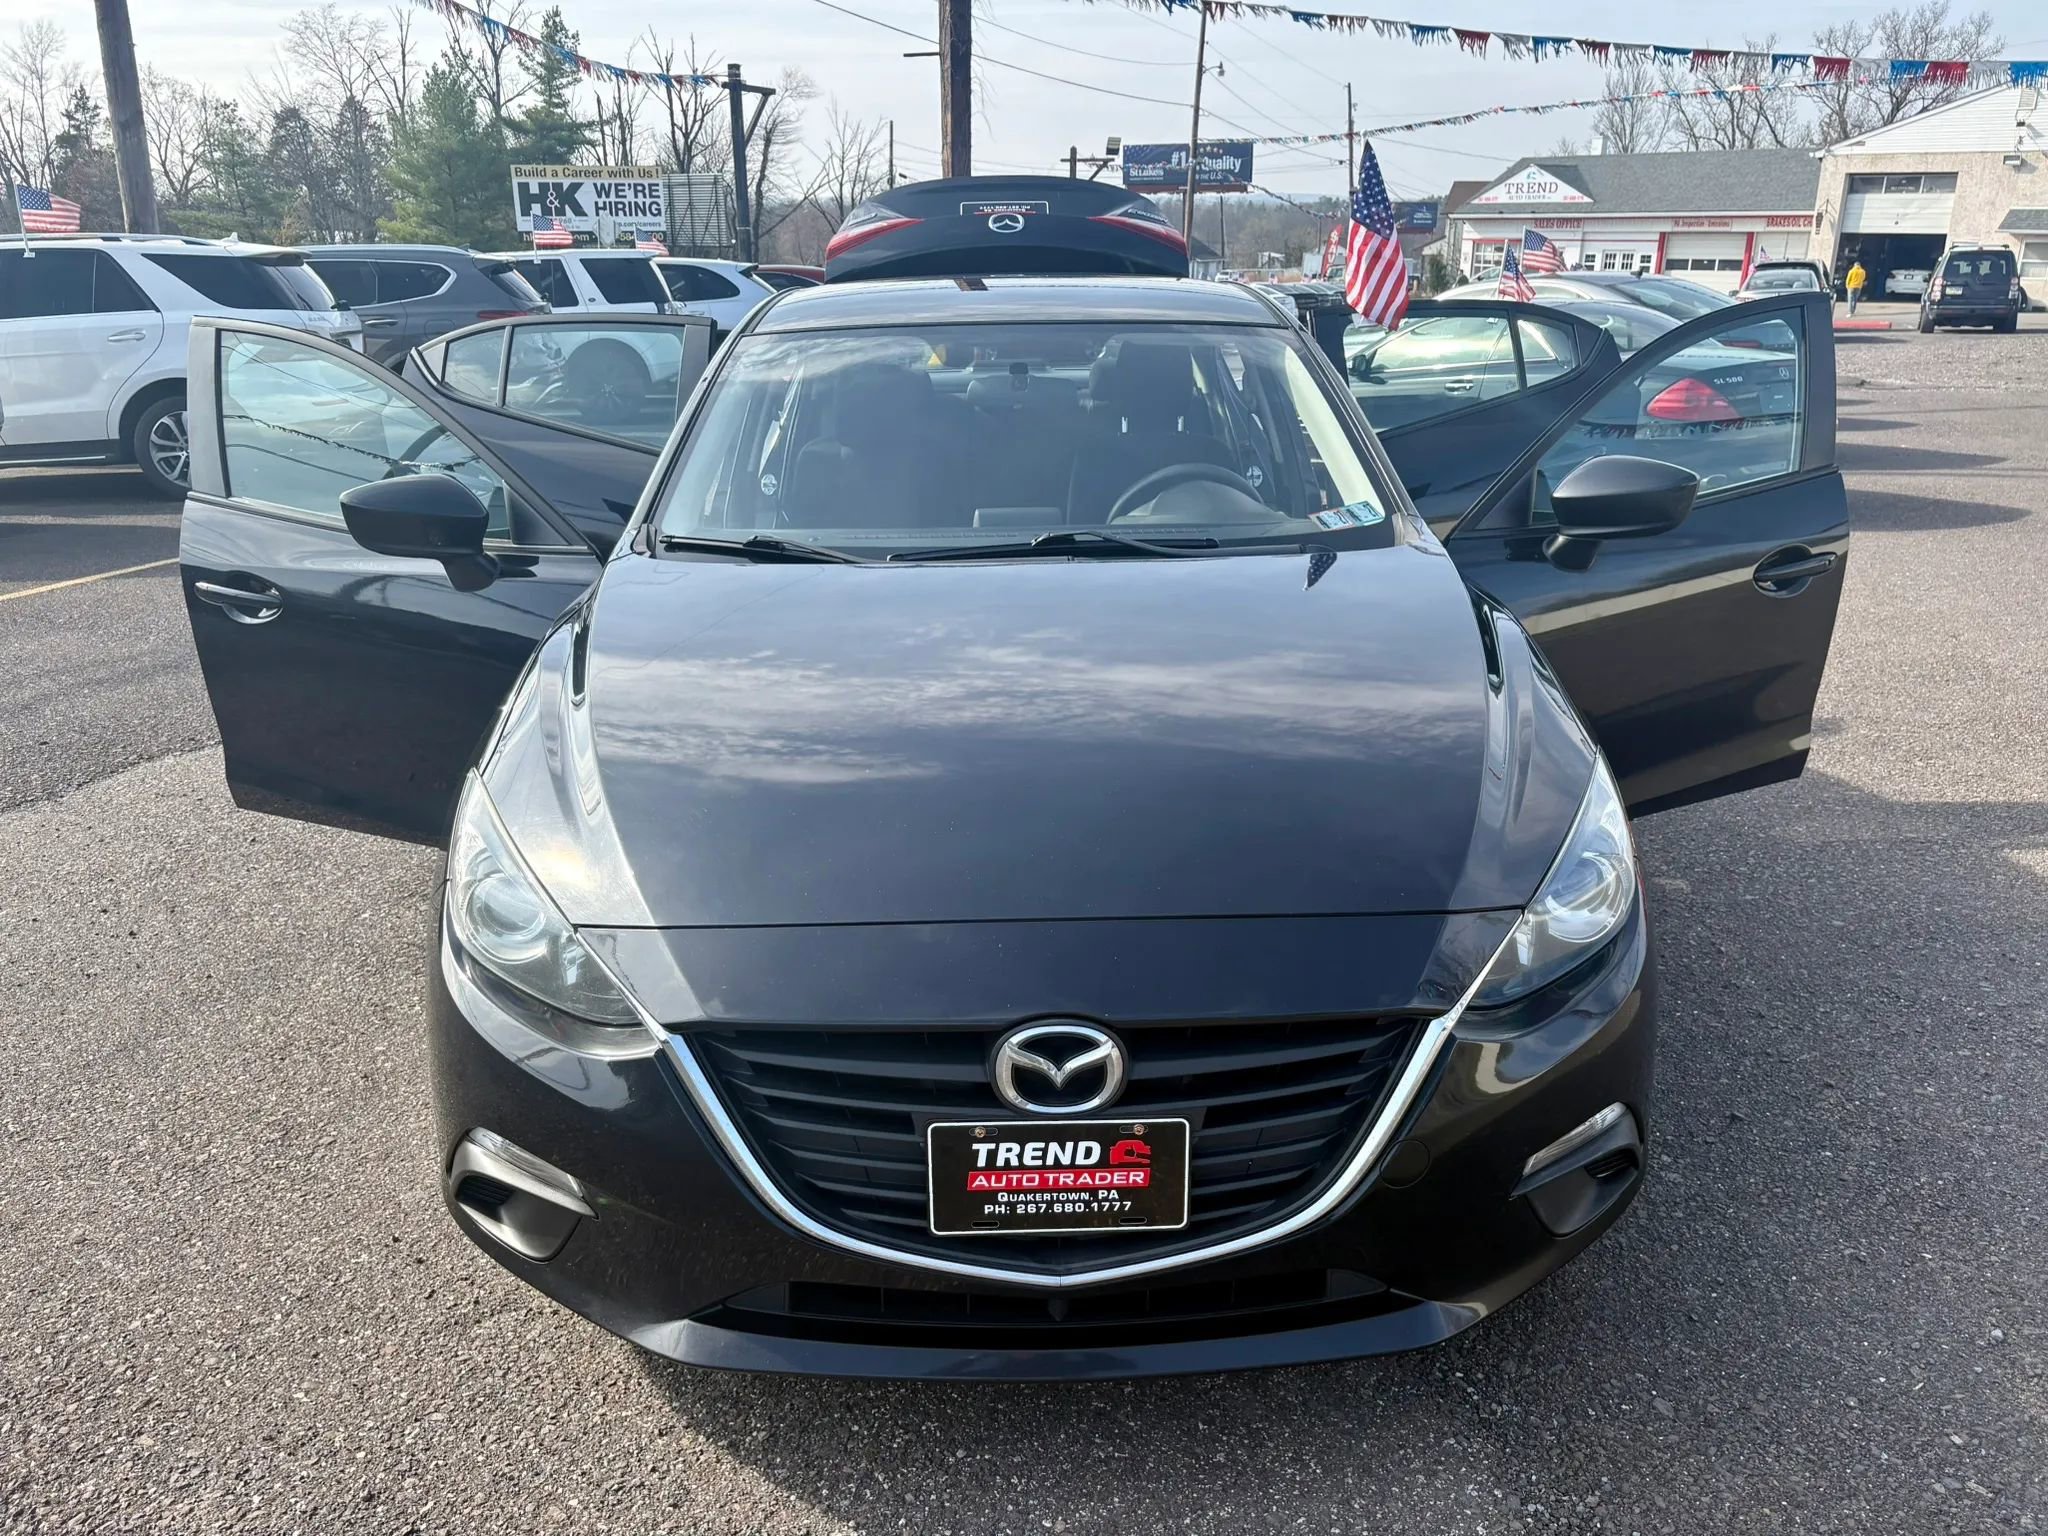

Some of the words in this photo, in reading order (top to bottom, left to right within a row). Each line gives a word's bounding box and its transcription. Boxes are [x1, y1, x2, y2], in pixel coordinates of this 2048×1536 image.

[1171, 151, 1188, 169] #1
[1201, 155, 1242, 173] Quality
[514, 166, 547, 178] Build
[551, 169, 559, 178] a
[562, 167, 604, 178] Career
[606, 168, 634, 178] with
[593, 182, 661, 199] WE'RE
[1504, 181, 1559, 195] TREND
[594, 201, 662, 217] HIRING
[1533, 218, 1555, 230] SALES
[1556, 218, 1583, 230] OFFICE
[971, 1141, 1102, 1168] TREND
[971, 1174, 1040, 1188] AUTO
[1044, 1171, 1145, 1186] TRADER
[1098, 1190, 1120, 1200] PA
[984, 1204, 1011, 1215] PH:
[1016, 1201, 1132, 1213] 267.680.1777
